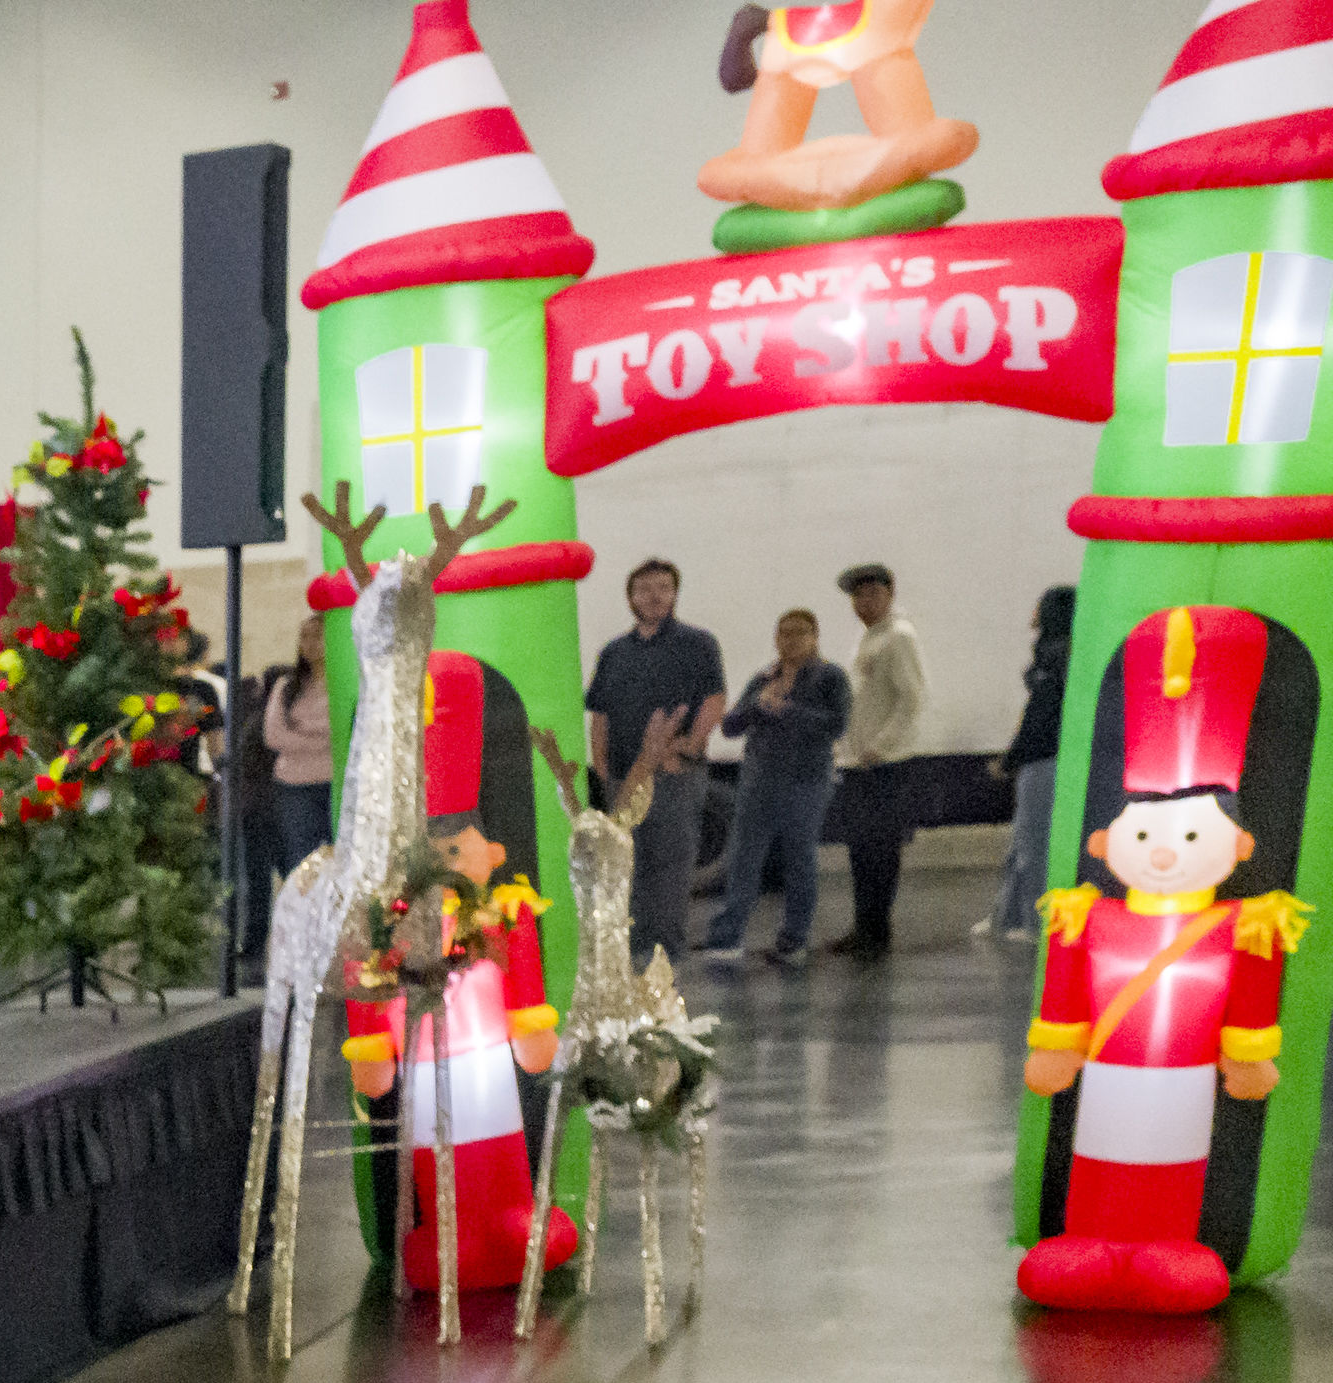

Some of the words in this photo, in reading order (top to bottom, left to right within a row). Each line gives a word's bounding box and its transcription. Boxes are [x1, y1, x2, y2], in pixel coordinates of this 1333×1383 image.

[708, 257, 935, 309] SANTA'S
[572, 317, 767, 426] TOY
[793, 285, 1079, 378] SHOP
